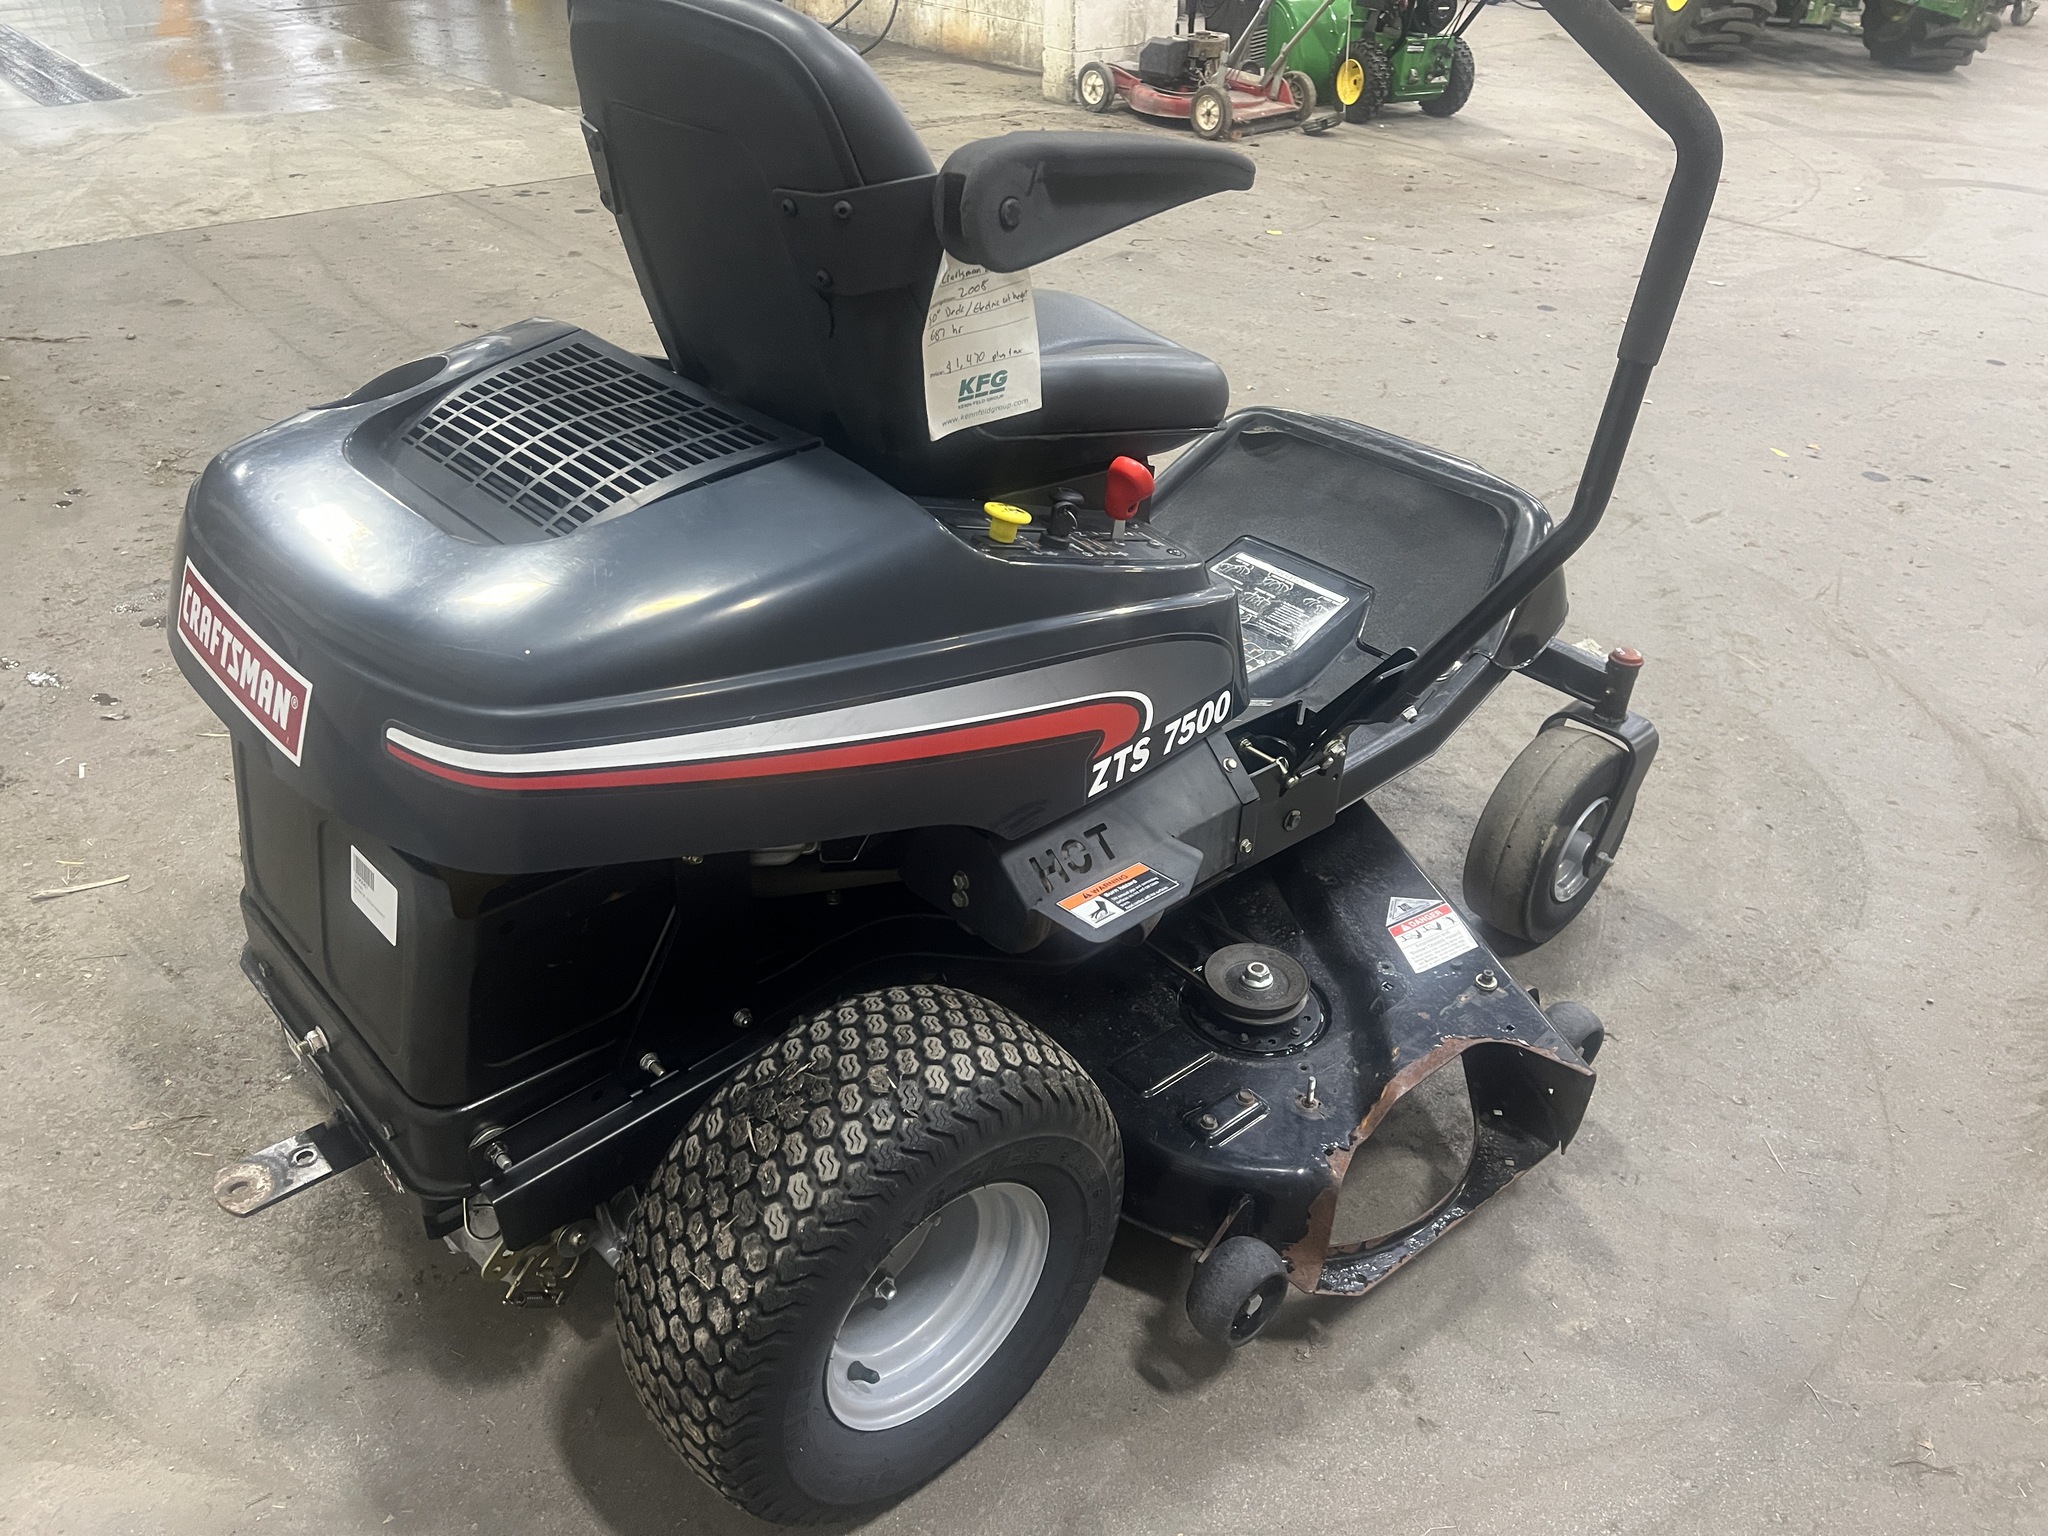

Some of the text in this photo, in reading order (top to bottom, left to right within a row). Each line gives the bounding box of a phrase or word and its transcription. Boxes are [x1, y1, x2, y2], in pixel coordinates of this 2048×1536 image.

[958, 279, 989, 298] 2008
[952, 324, 964, 335] hr
[959, 369, 1008, 397] KFG
[942, 398, 1029, 427] www.kennfeldgroup.com
[182, 582, 292, 731] CRAFTSMAN
[1088, 690, 1231, 798] ZTS 7500
[1029, 822, 1115, 894] HOT
[1091, 873, 1128, 894] WARNING
[1410, 909, 1444, 928] DANGER
